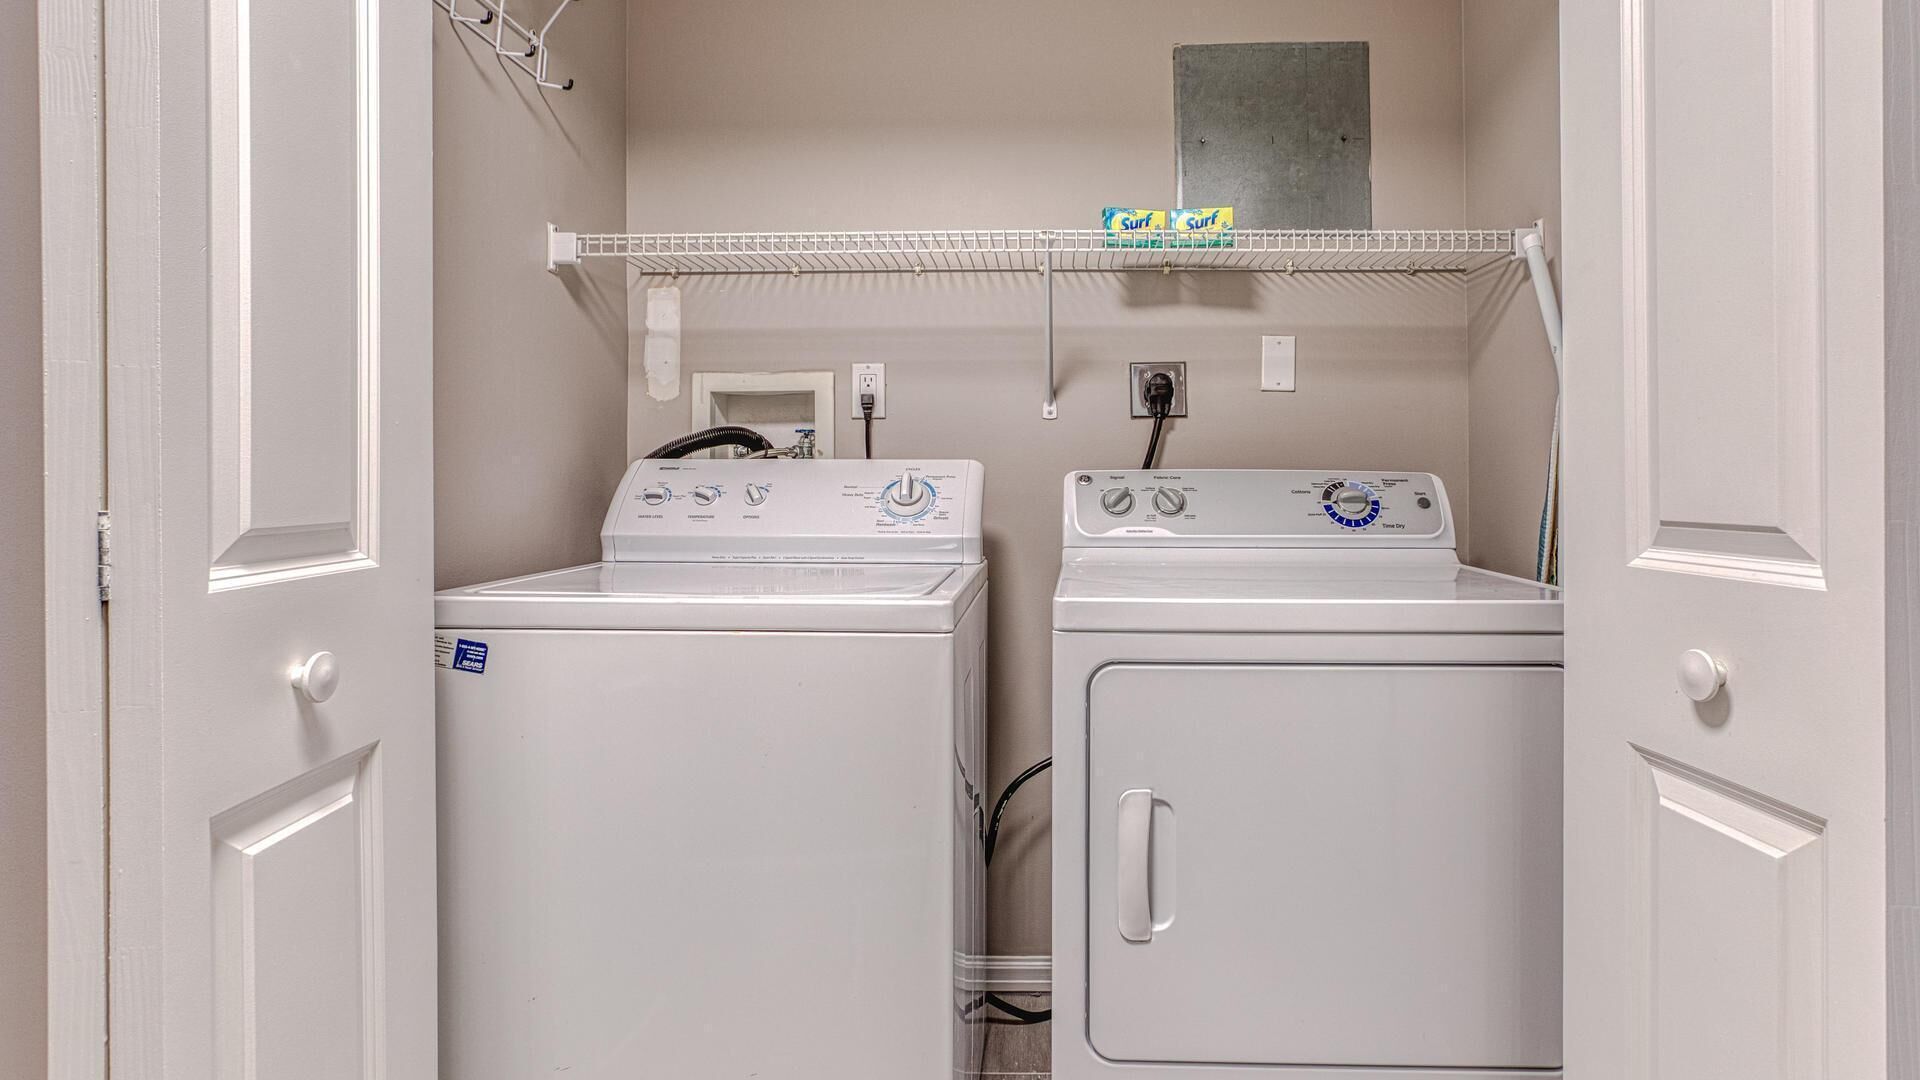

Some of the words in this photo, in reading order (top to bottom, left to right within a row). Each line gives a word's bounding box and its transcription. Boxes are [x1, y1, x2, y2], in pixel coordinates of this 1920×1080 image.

[1121, 212, 1153, 230] Surf
[1186, 210, 1219, 230] Surf
[462, 660, 483, 668] SEARS
